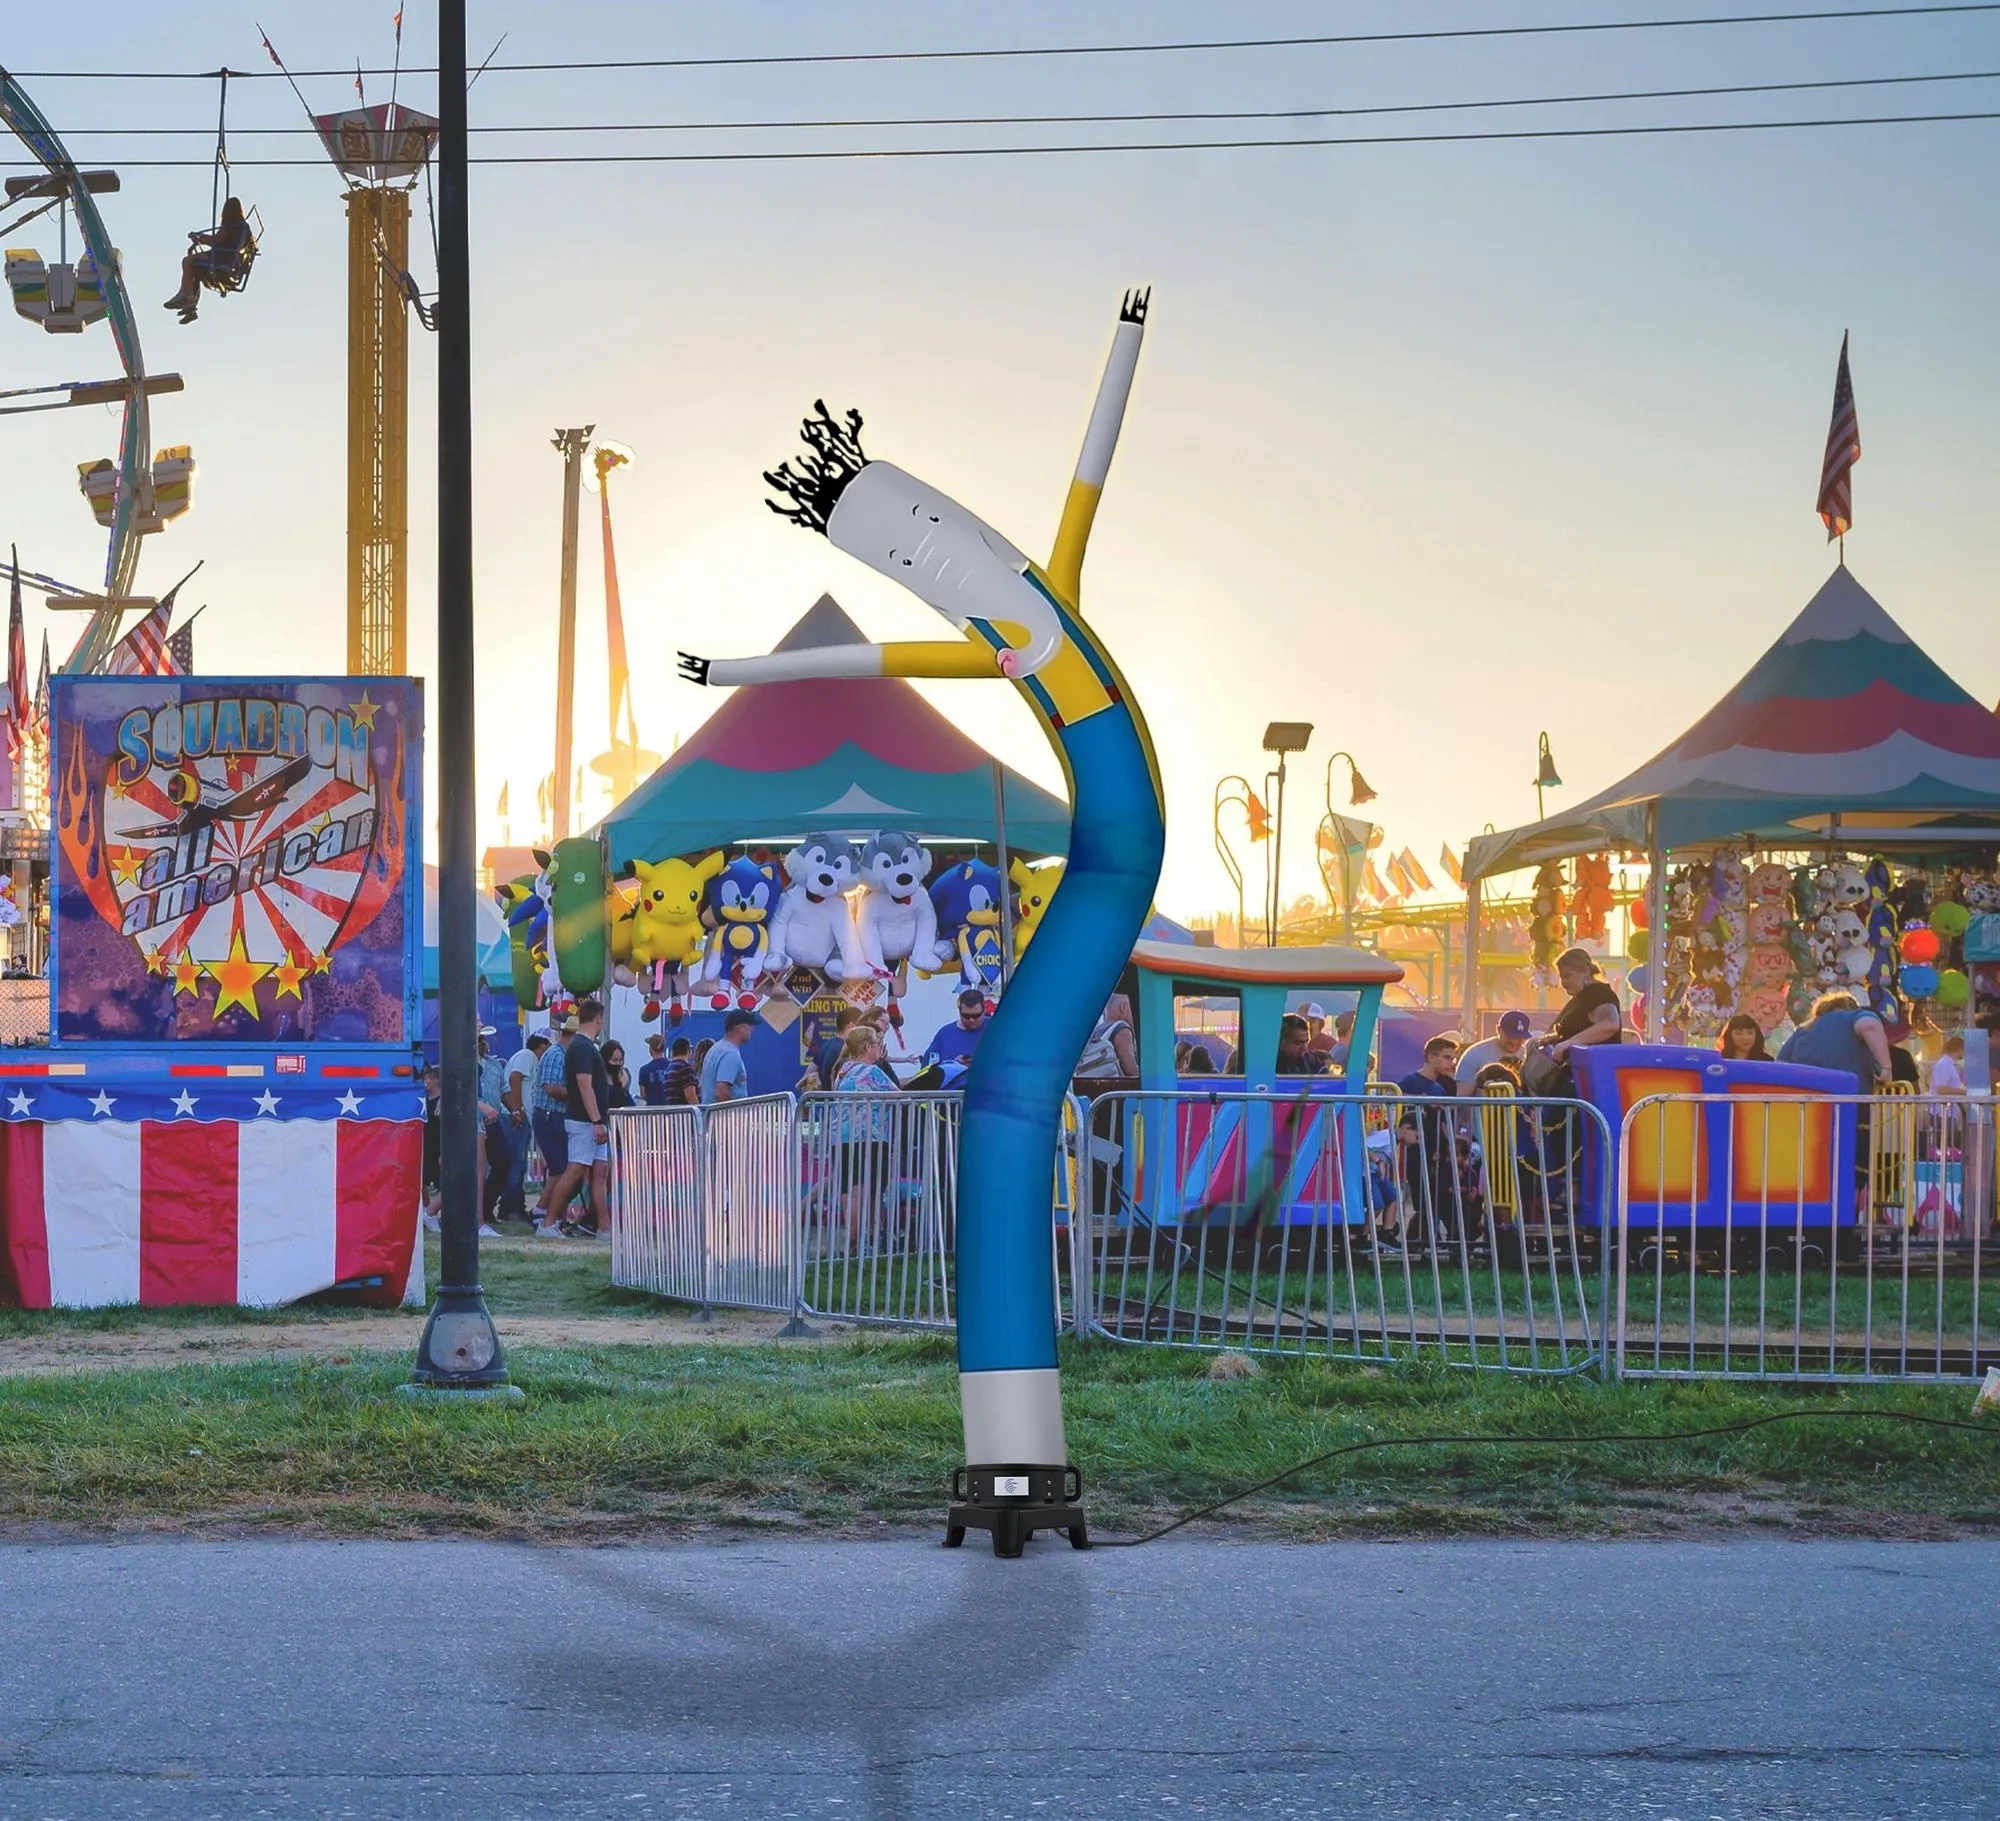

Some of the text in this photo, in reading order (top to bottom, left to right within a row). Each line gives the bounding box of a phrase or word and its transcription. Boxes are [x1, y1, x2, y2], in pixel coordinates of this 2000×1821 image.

[117, 699, 370, 795] SQUADRON
[120, 808, 376, 936] american
[139, 825, 216, 892] all
[976, 954, 1001, 967] CHOIC
